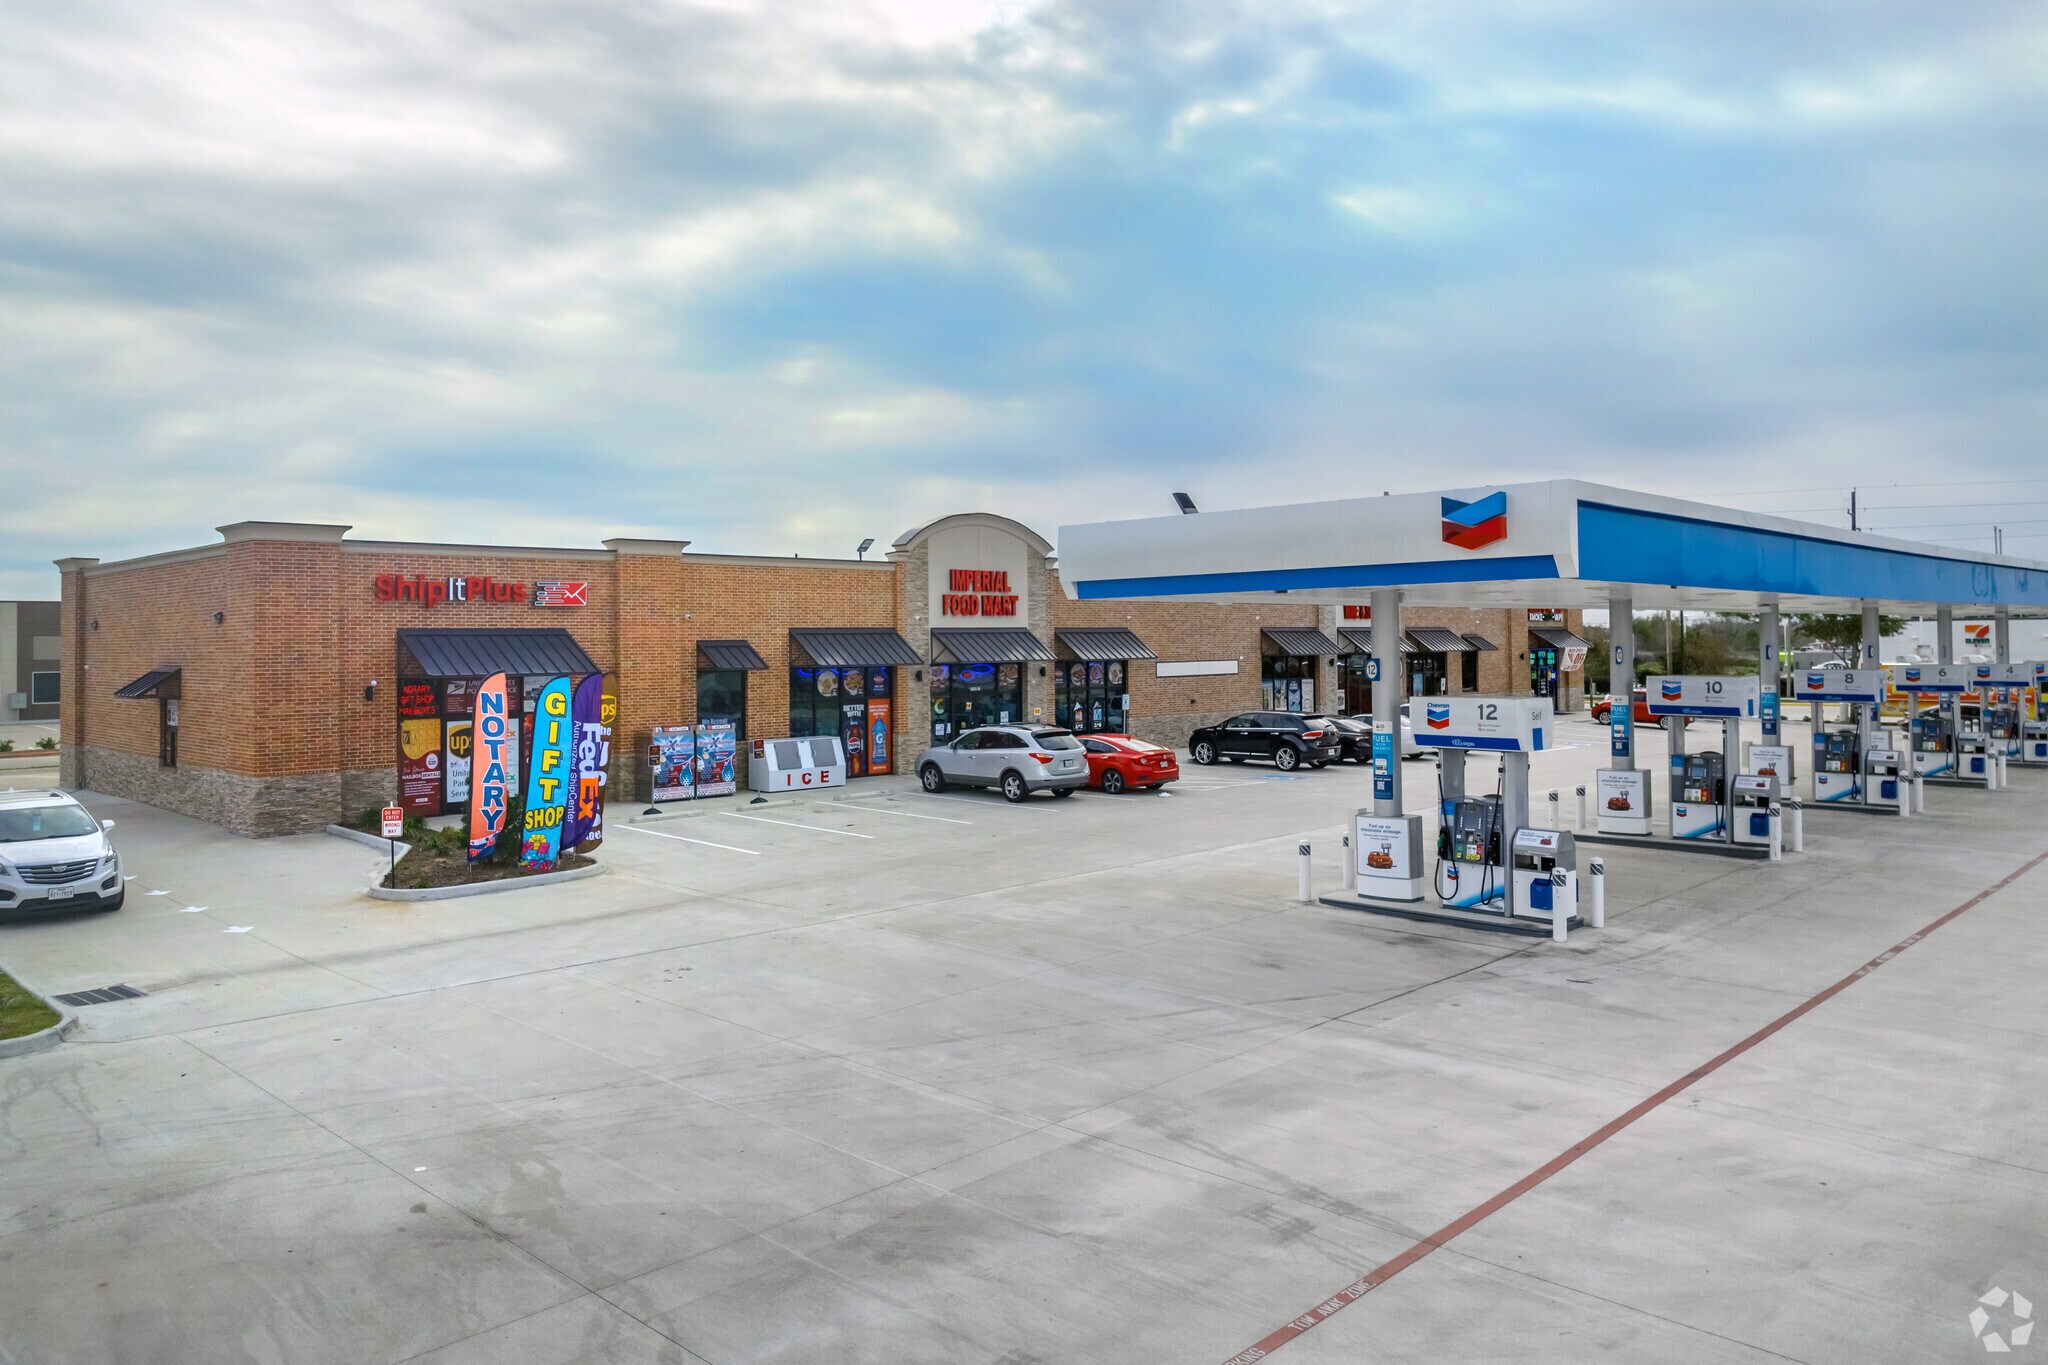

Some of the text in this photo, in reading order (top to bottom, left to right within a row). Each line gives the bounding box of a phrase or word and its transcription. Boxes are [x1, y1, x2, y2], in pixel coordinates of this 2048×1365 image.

[949, 568, 1012, 593] IMPERIAL
[375, 574, 528, 609] ShipItPlus
[942, 594, 1019, 616] FOOD MART
[1367, 664, 1376, 675] 12
[1938, 668, 1947, 677] 6
[2006, 666, 2014, 674] 4
[1844, 673, 1854, 684] 8
[403, 685, 431, 694] NOTARY
[1705, 681, 1723, 694] 10
[416, 695, 435, 704] SHOP
[398, 706, 436, 715] MAILBOXES
[601, 703, 616, 720] ps
[842, 704, 865, 712] BETTER
[1477, 704, 1498, 720] 12
[1532, 711, 1542, 720] Self
[875, 733, 883, 744] G
[538, 691, 567, 803] GIFT
[479, 692, 506, 832] NOTARY
[577, 721, 601, 822] FedEx
[787, 770, 830, 786] ICE
[566, 771, 578, 824] ShipCenter
[524, 805, 566, 832] SHOP
[1287, 1278, 1377, 1331] TOW AWAY ZONE
